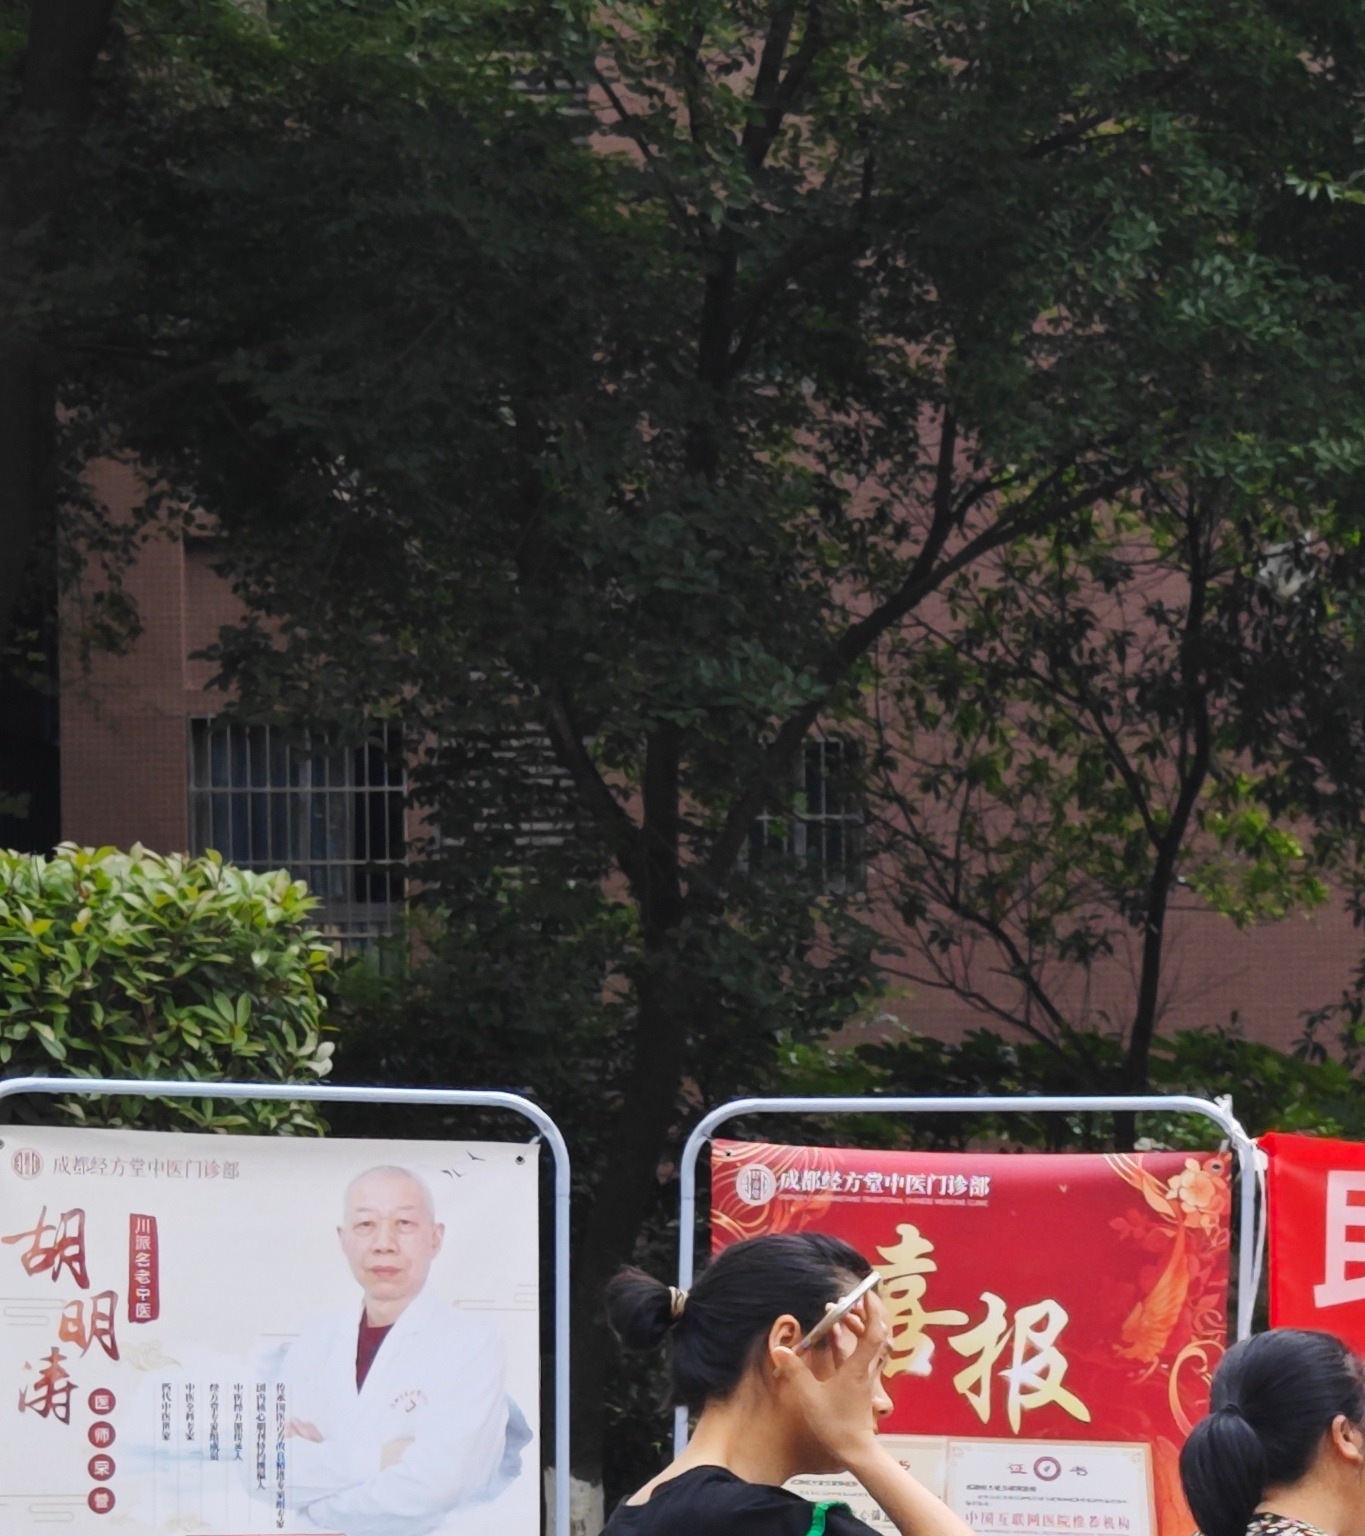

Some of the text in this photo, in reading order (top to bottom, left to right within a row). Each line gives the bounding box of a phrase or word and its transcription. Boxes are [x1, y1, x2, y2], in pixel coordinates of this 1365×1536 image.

[53, 1155, 241, 1181] 成都经方堂中医门诊部
[779, 1170, 990, 1197] 成都经方堂中医门诊部
[134, 1216, 152, 1320] 川派名老中医
